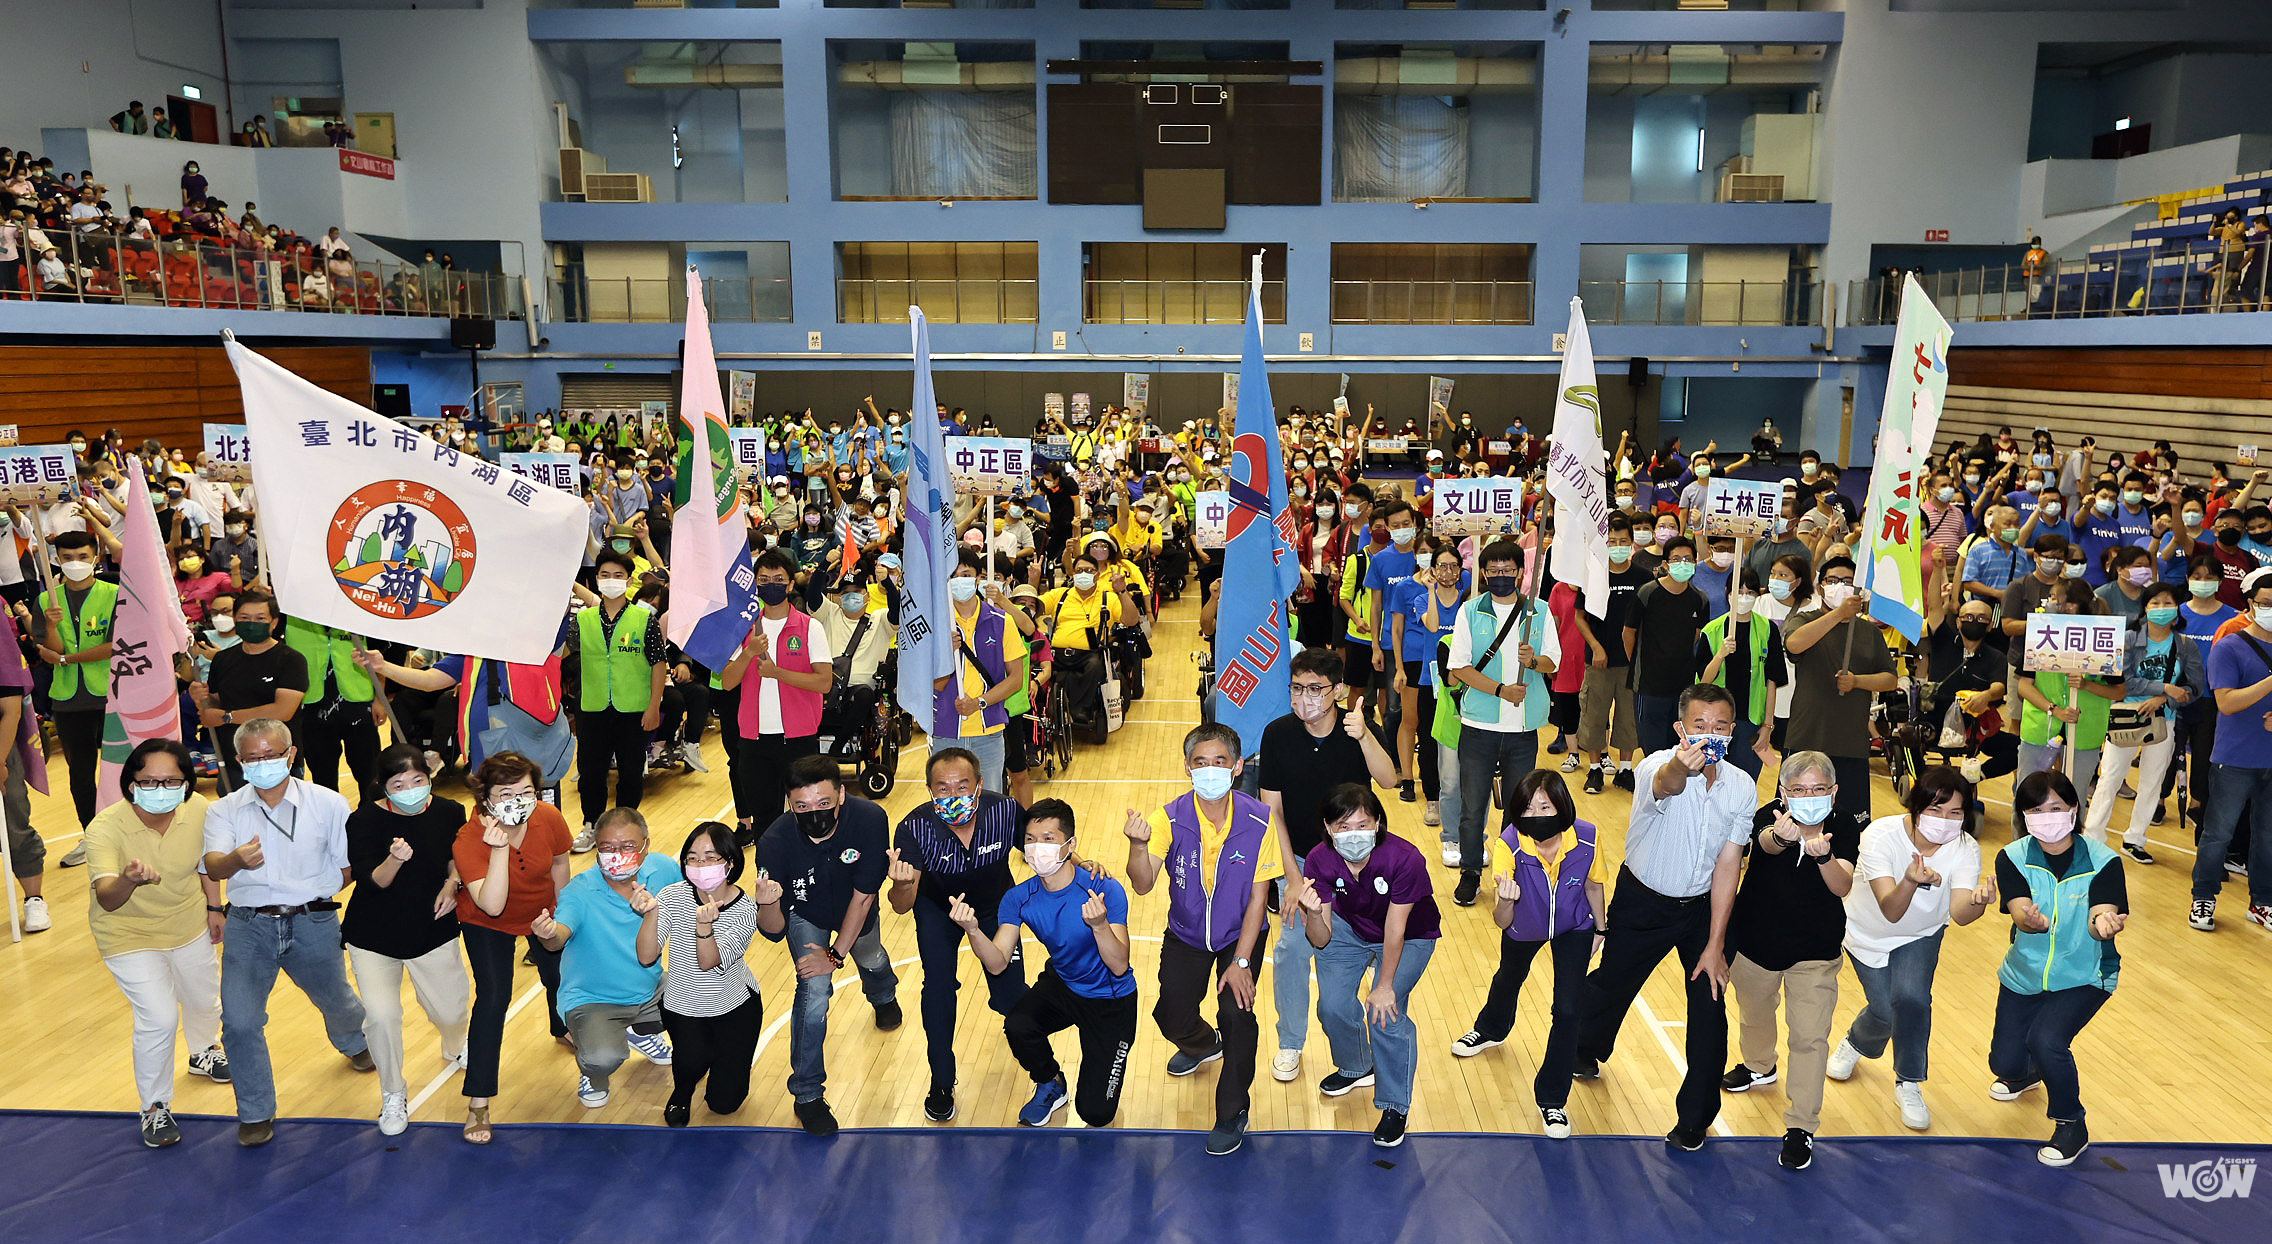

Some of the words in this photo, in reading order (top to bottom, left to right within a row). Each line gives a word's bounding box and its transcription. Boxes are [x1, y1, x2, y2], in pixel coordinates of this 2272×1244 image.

[1142, 90, 1150, 99] H
[1220, 91, 1228, 99] G
[811, 336, 820, 347] 禁
[1054, 336, 1065, 347] 止
[1301, 336, 1312, 348] 飲
[298, 420, 538, 507] 臺北市內湖區
[956, 447, 1023, 475] 中正區
[396, 495, 431, 509] Happiness
[1443, 488, 1513, 515] 文山區
[1715, 489, 1776, 518] 士林區
[335, 497, 365, 530] 人文
[396, 481, 435, 502] 幸福
[456, 523, 474, 558] 宜居
[381, 504, 421, 616] 內湖
[352, 589, 376, 602] Nei
[372, 602, 396, 614] -Hu
[2035, 624, 2116, 653] 大同區
[618, 645, 641, 653] TAIPEI
[977, 841, 1003, 856] TAIPEI
